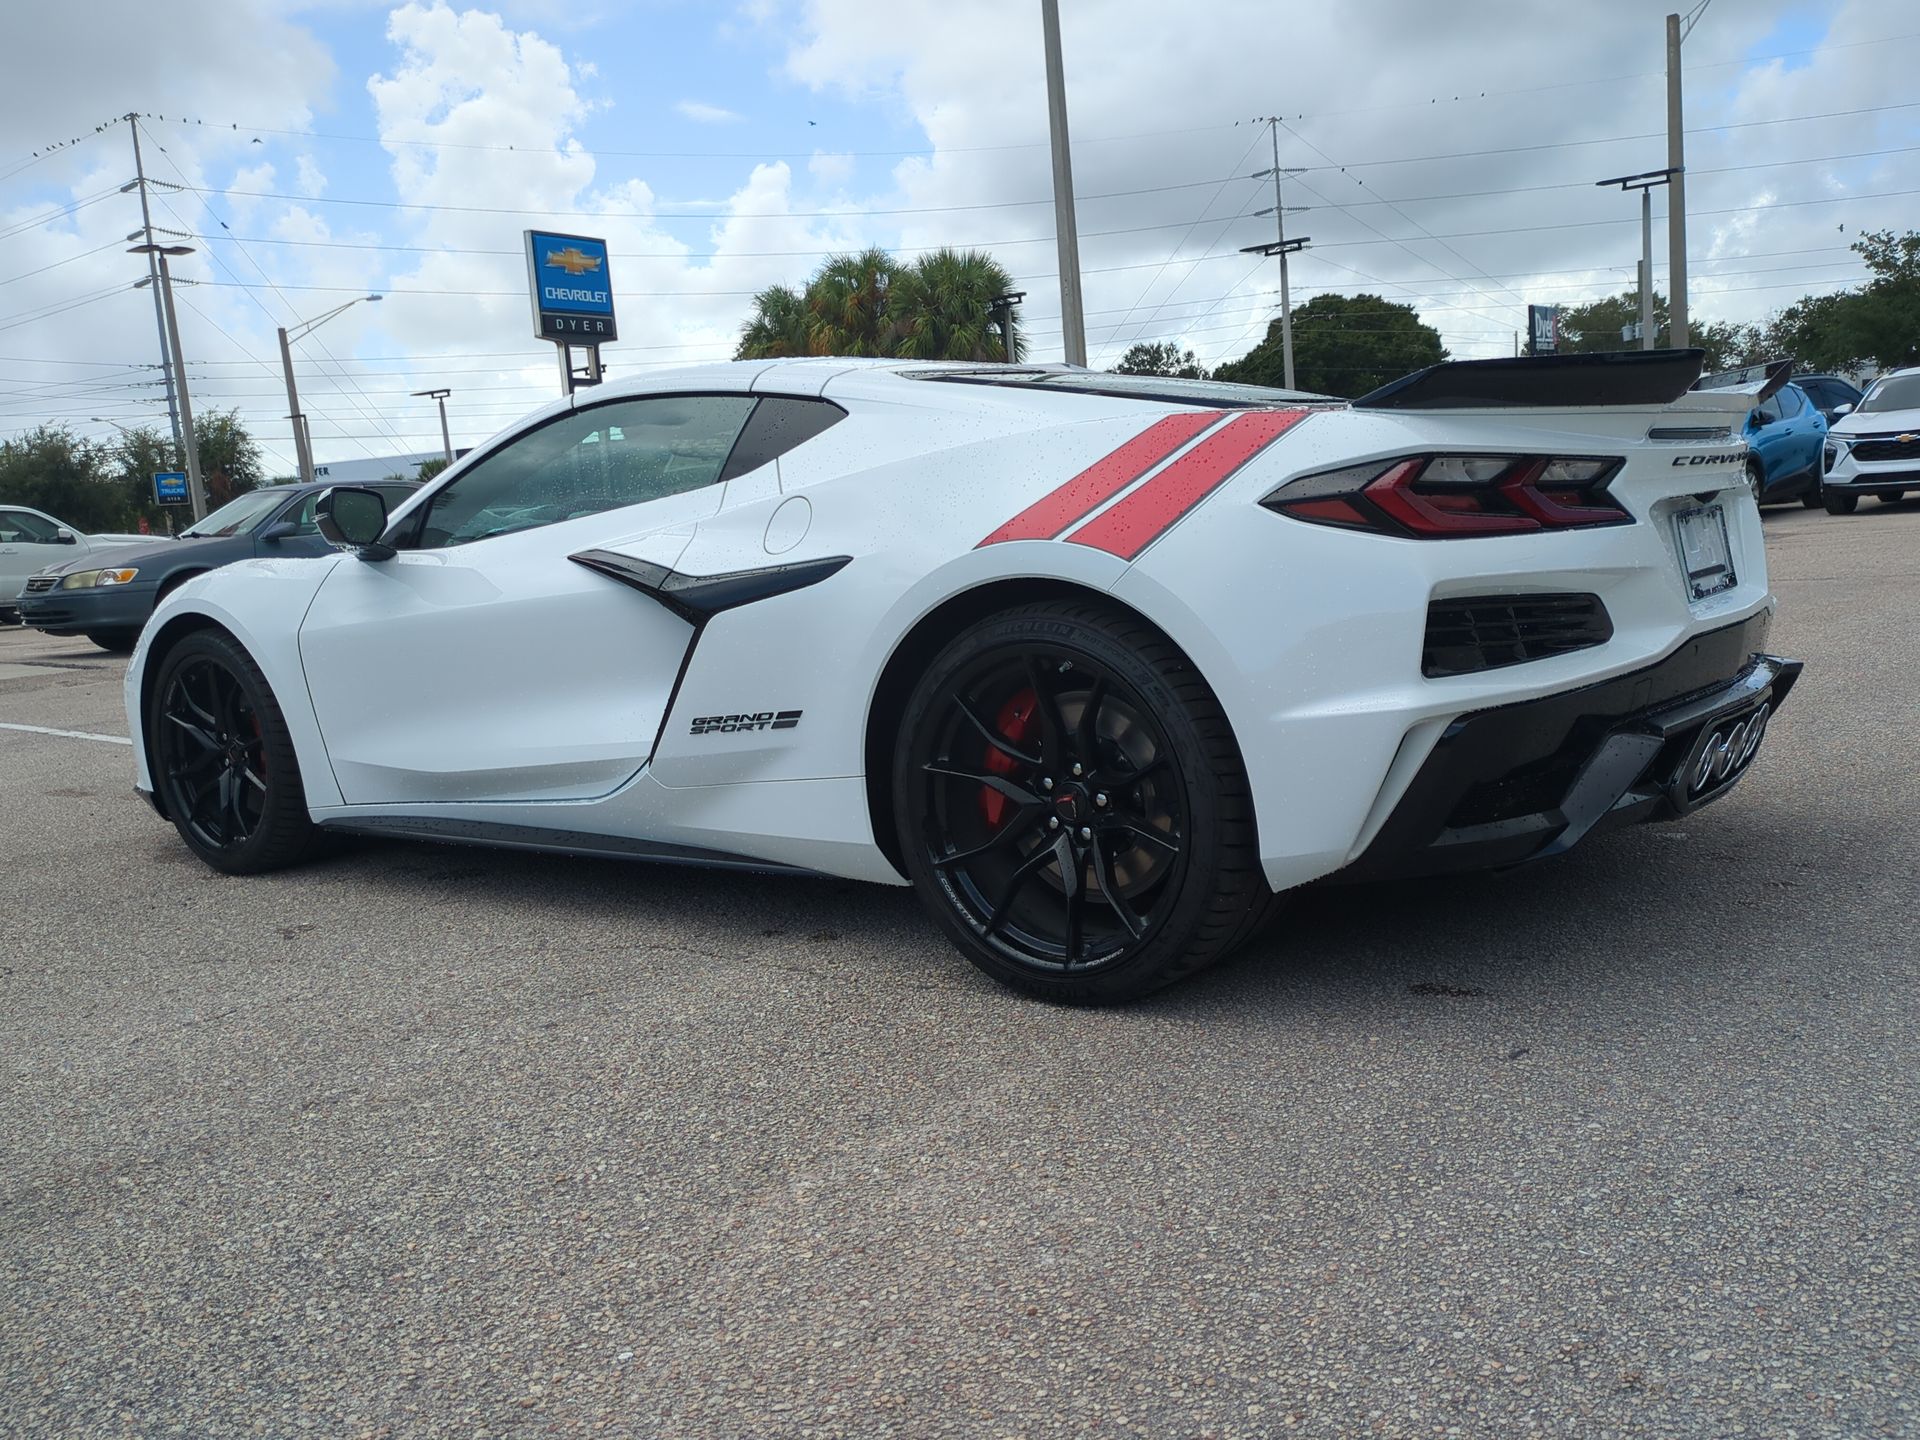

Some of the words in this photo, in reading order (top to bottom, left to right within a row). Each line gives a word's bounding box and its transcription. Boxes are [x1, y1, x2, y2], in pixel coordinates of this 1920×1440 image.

[545, 287, 608, 303] CHEVROLET
[556, 319, 604, 332] DYER
[314, 467, 330, 476] YER
[691, 712, 774, 726] GRAND
[689, 721, 771, 735] SPORT
